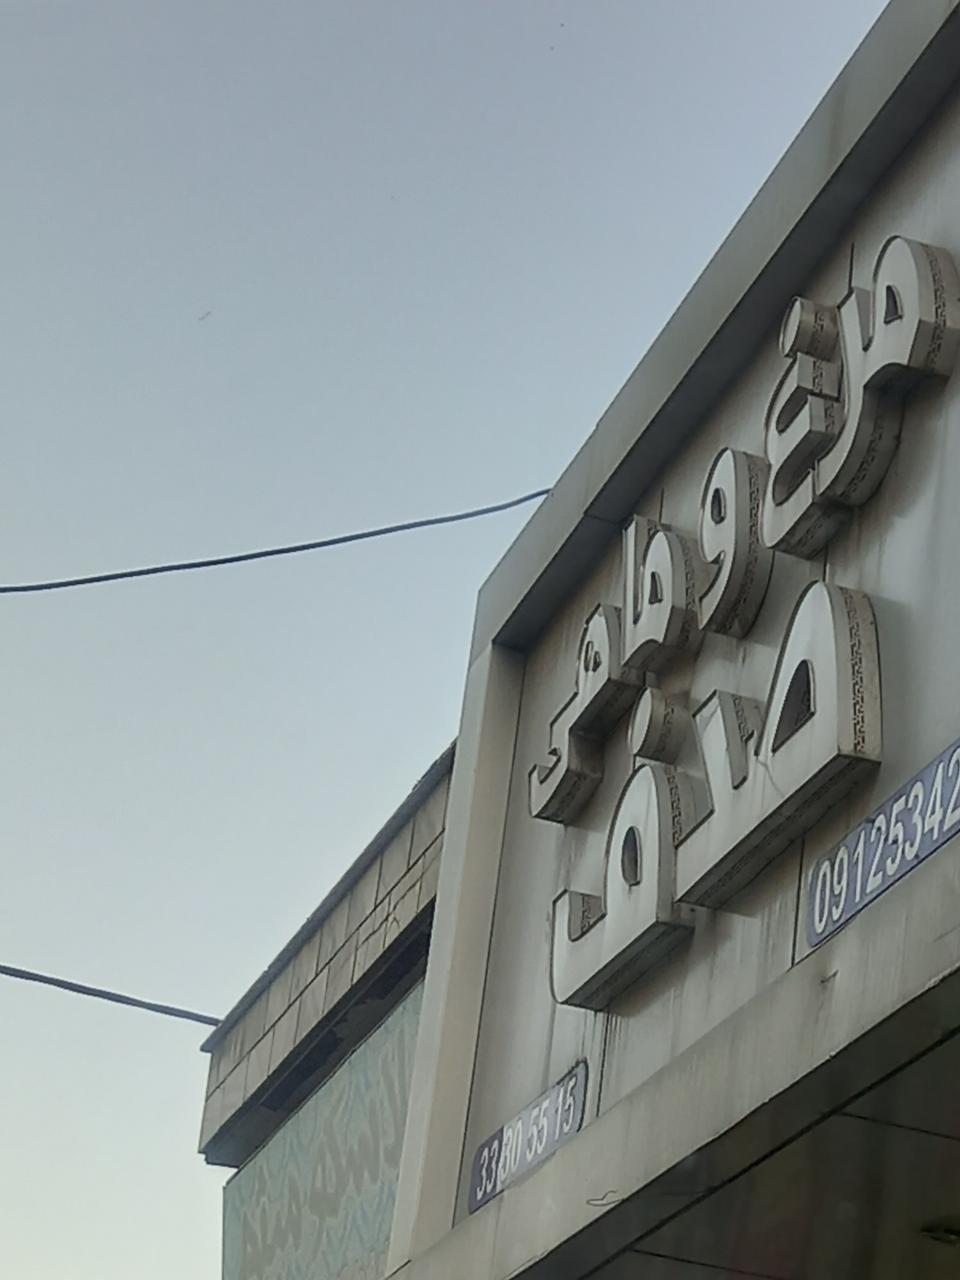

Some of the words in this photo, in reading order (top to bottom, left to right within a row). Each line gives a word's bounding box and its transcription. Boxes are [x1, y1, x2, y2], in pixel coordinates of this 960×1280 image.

[698, 448, 762, 634] و
[762, 235, 950, 555] مرغ
[529, 512, 692, 822] ماهی
